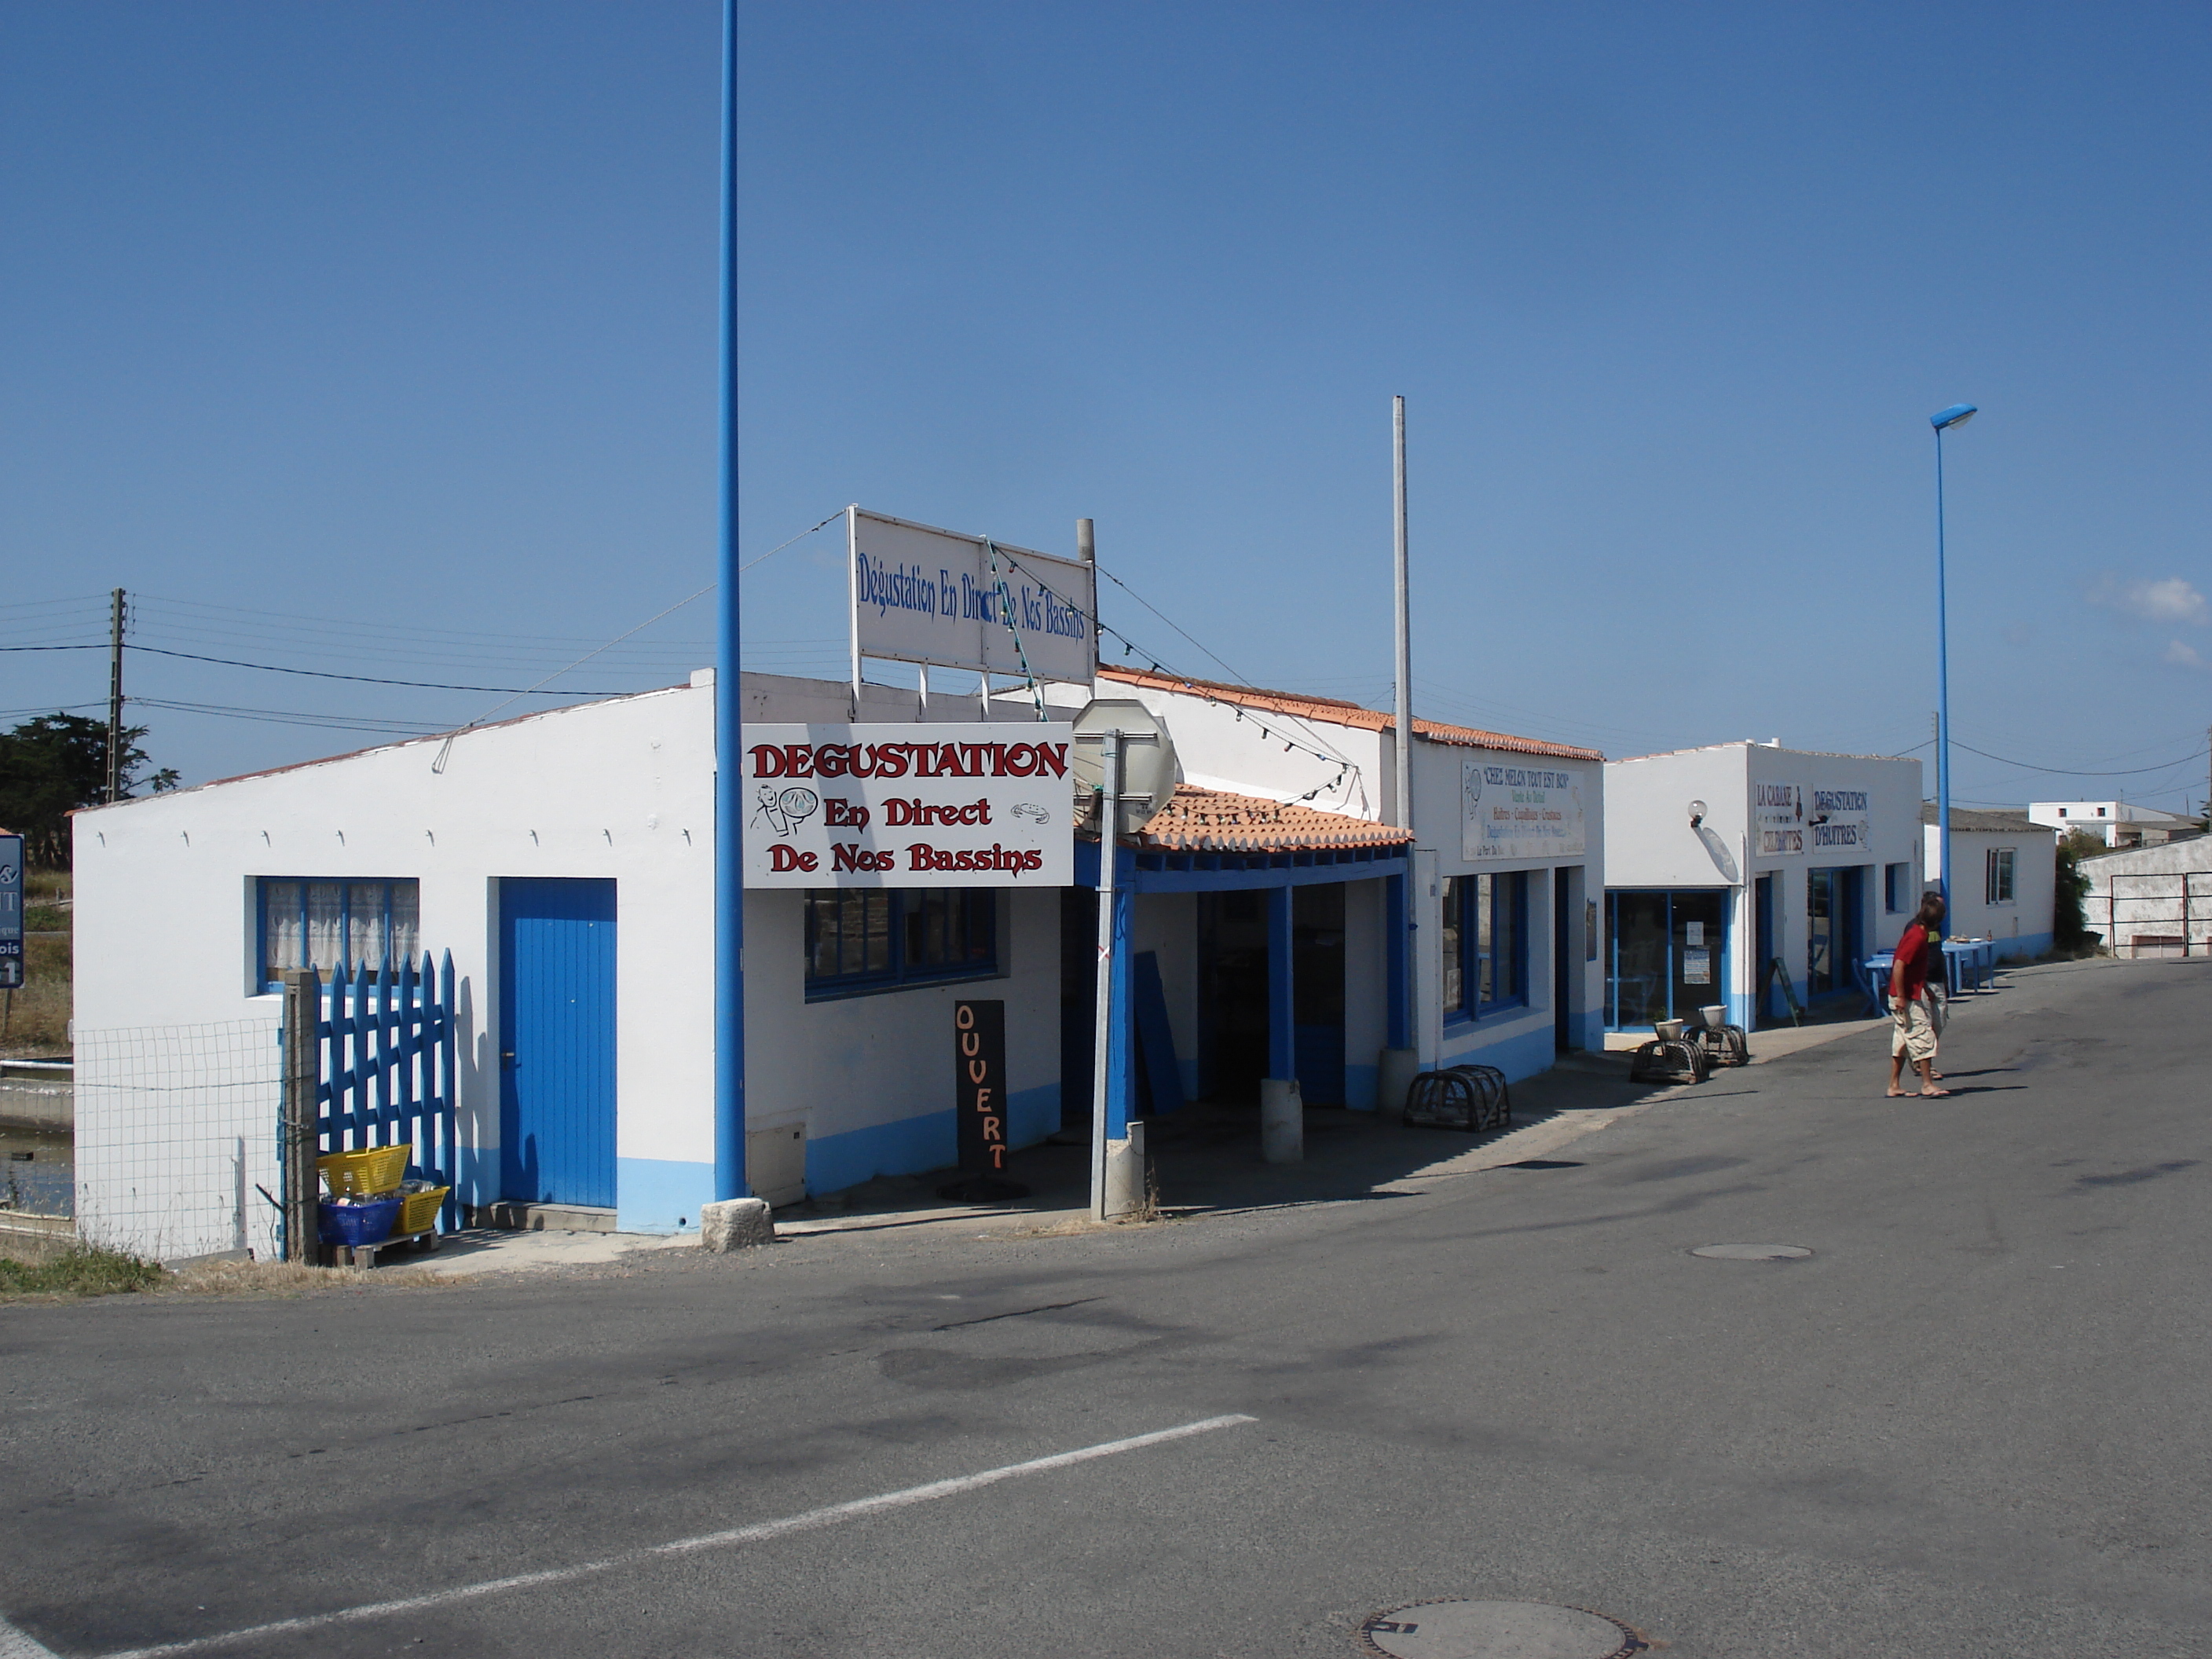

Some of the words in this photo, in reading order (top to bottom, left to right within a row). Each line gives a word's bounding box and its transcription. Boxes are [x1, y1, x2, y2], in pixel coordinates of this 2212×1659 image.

[859, 552, 936, 623] Dégustation
[940, 569, 957, 626] En
[1002, 581, 1017, 626] De
[1021, 585, 1042, 632] Nos
[1046, 591, 1085, 644] Bassins
[748, 741, 1069, 780] DEGUSTATION
[1505, 769, 1526, 786] MELON
[1527, 771, 1542, 788] TOUT
[1544, 771, 1555, 789] EST
[1757, 784, 1767, 807] LA
[1814, 790, 1867, 811] DEGUSTATION
[823, 797, 870, 835] En
[881, 798, 993, 827] Direct
[767, 844, 819, 873] De
[831, 843, 895, 874] Nos
[905, 842, 1043, 878] Bassins
[956, 1005, 1006, 1169] OUVERT
